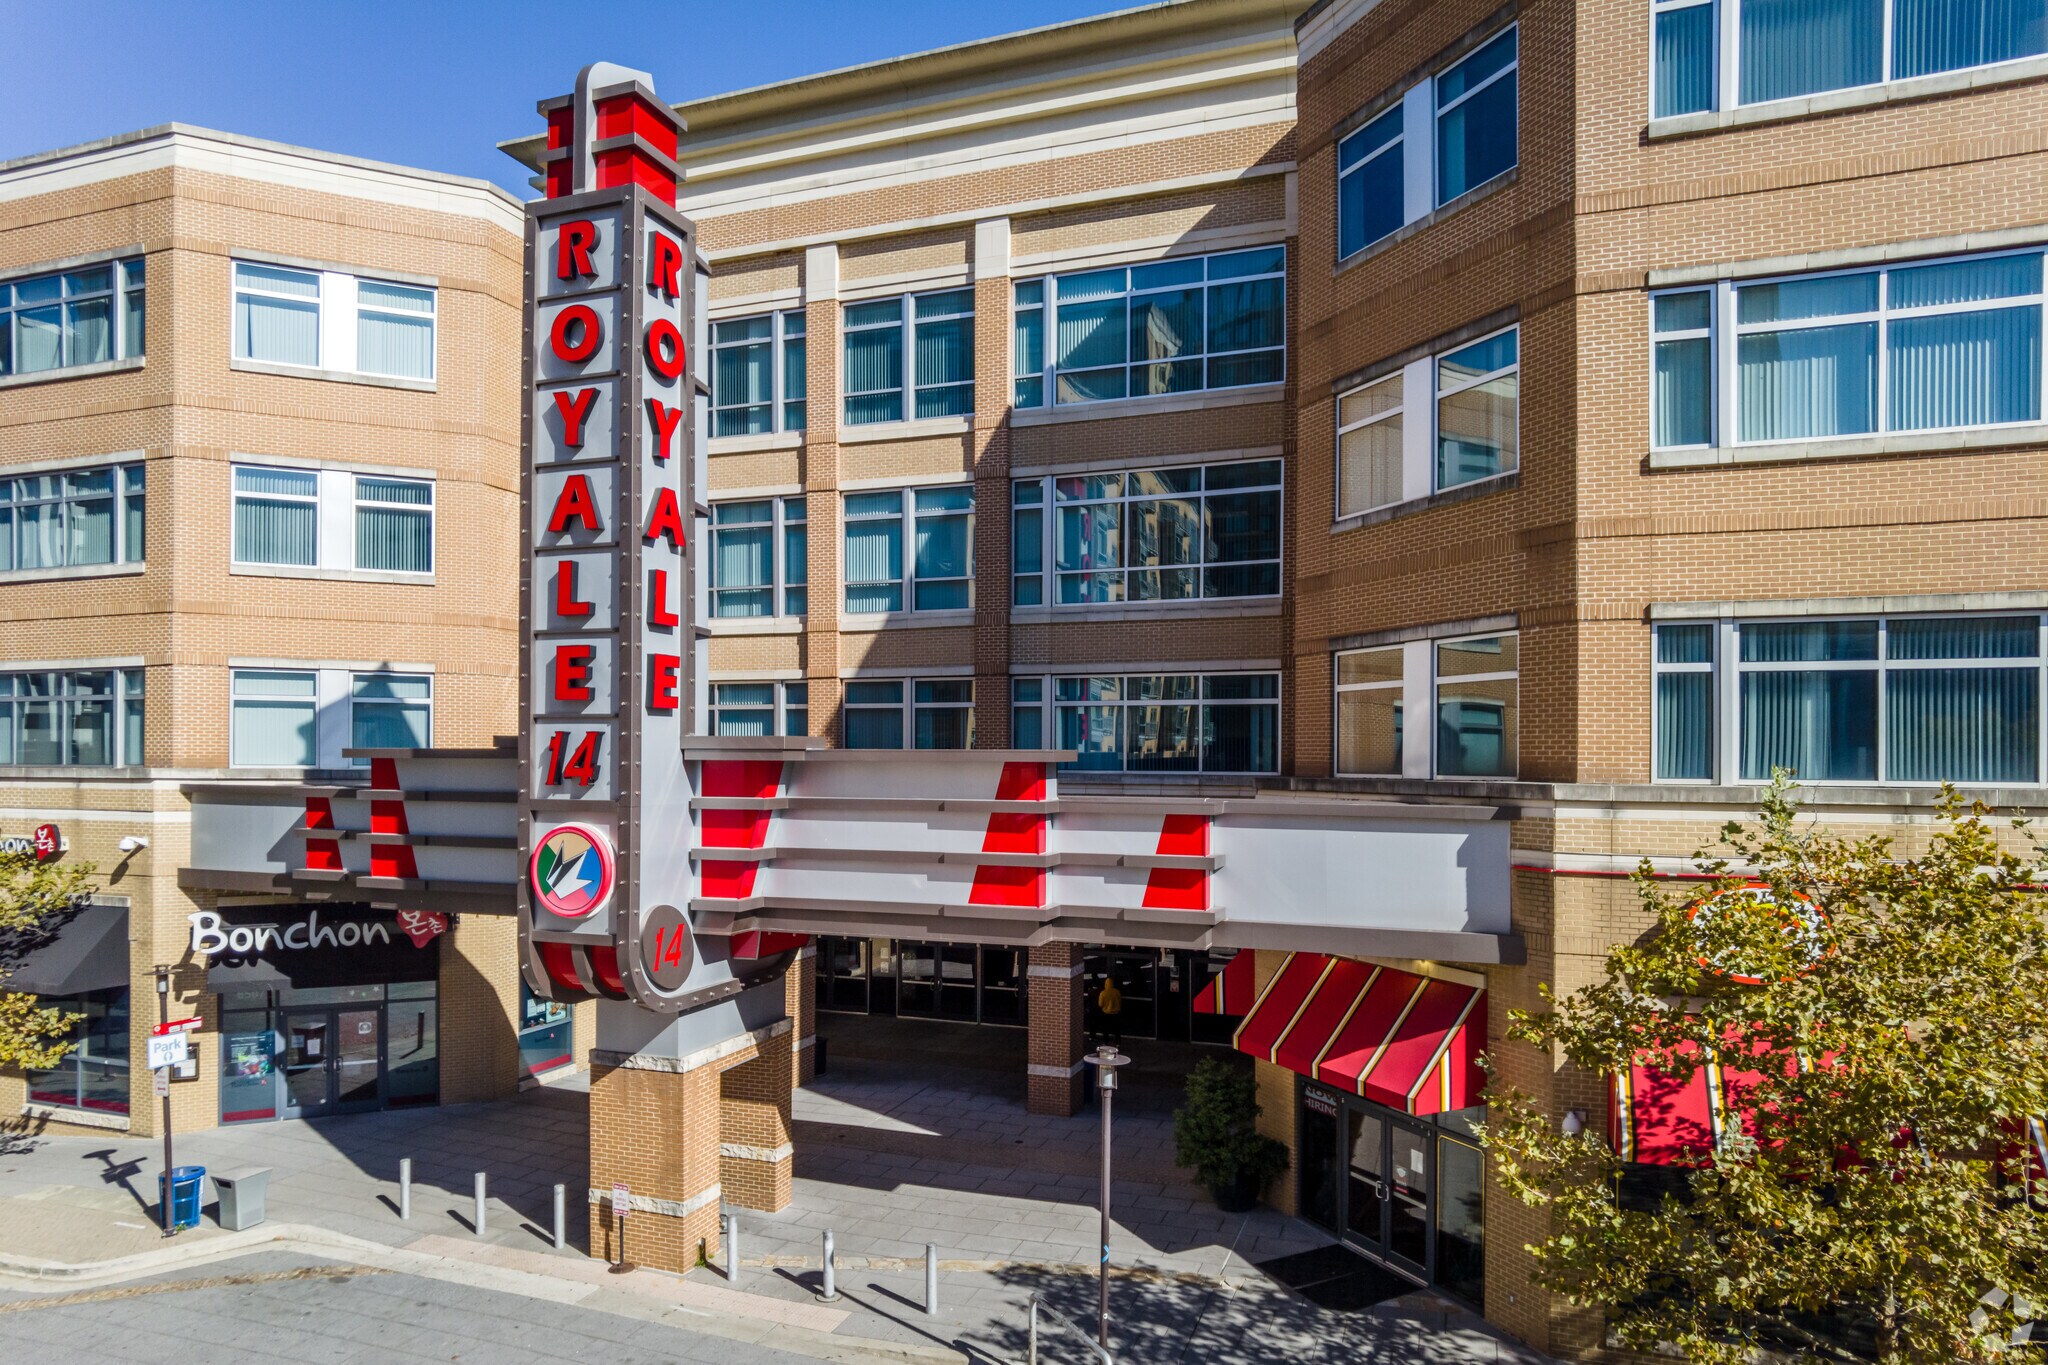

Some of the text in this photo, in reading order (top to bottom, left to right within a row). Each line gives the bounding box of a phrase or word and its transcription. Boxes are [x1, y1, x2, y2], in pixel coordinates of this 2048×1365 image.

[547, 219, 604, 701] ROYALE
[645, 230, 686, 709] ROYALE
[545, 730, 604, 787] 14
[187, 909, 390, 955] Bonchon
[653, 923, 685, 972] 14
[153, 1039, 182, 1054] Park
